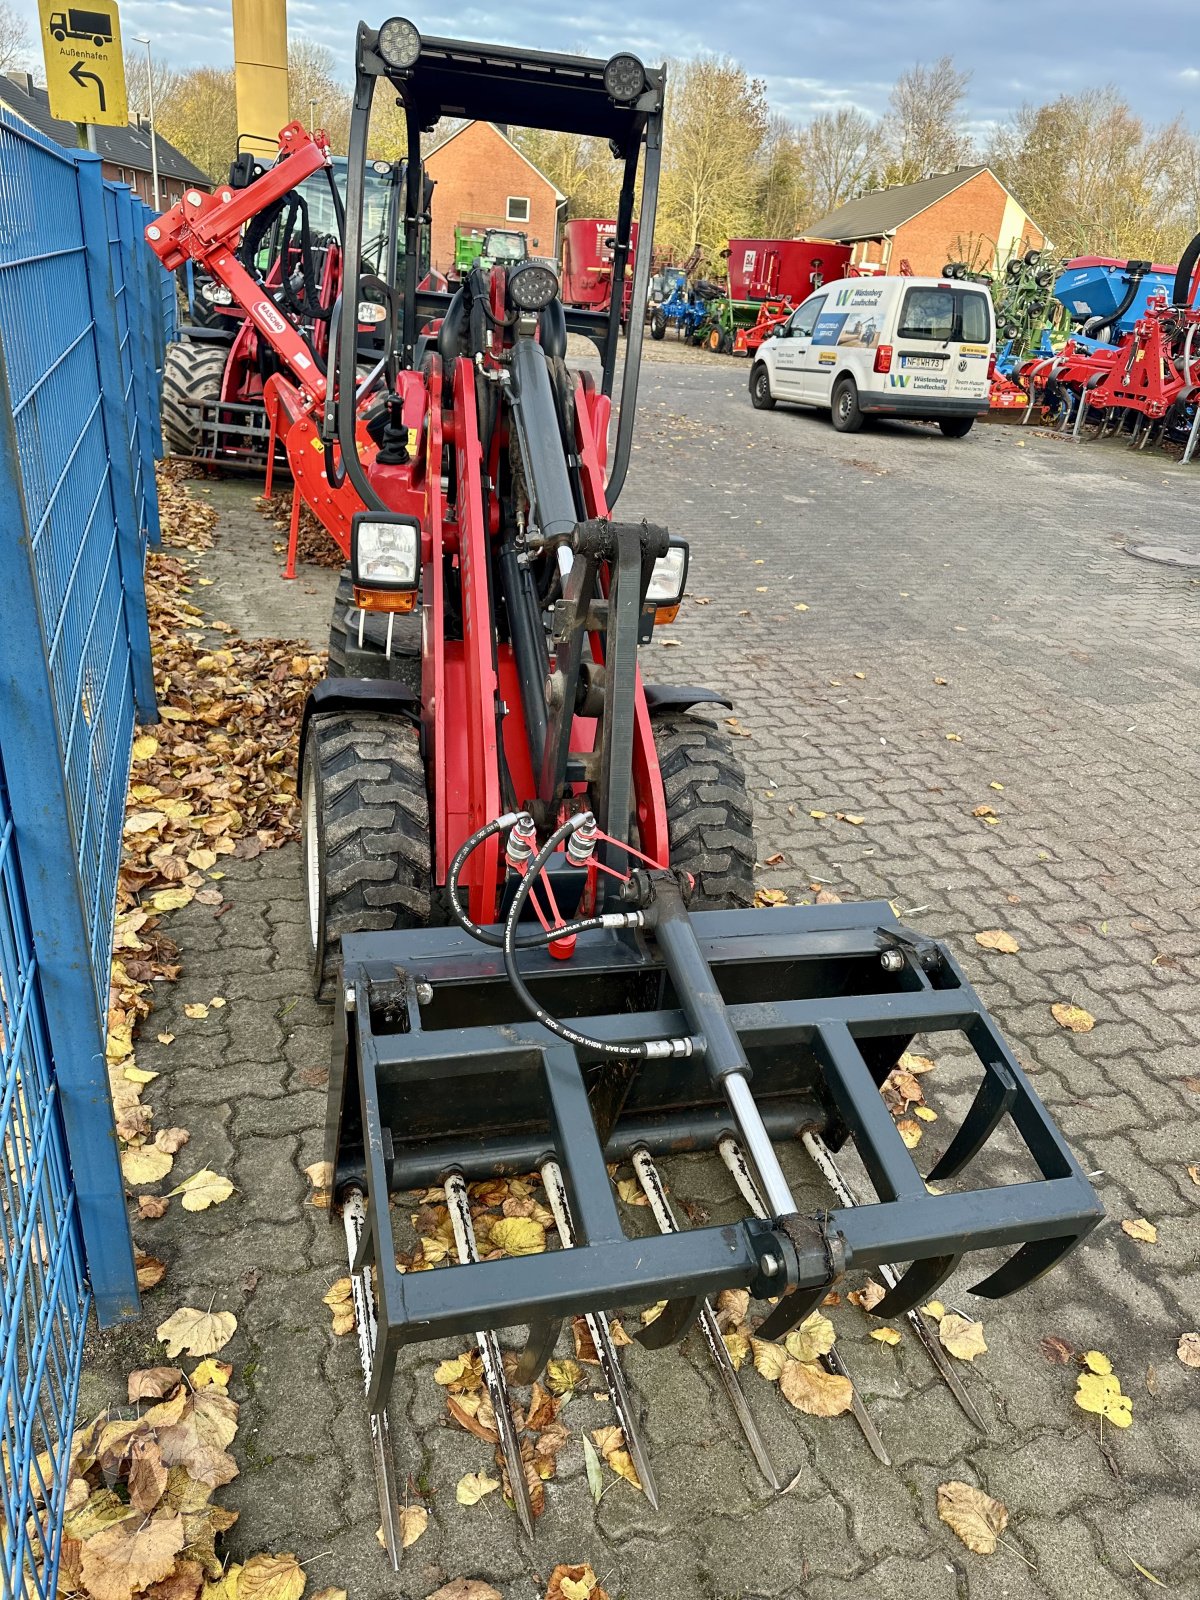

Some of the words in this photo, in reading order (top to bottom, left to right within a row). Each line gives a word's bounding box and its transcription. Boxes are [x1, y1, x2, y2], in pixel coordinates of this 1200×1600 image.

[59, 47, 108, 61] Außenhafen
[855, 289, 883, 298] Wüstenberg
[851, 298, 878, 306] Landtechnik
[260, 304, 283, 331] MASCHIO
[907, 358, 917, 366] NF
[931, 359, 940, 368] 73
[914, 376, 948, 385] Wüstenberg
[913, 383, 946, 391] Landtechnik
